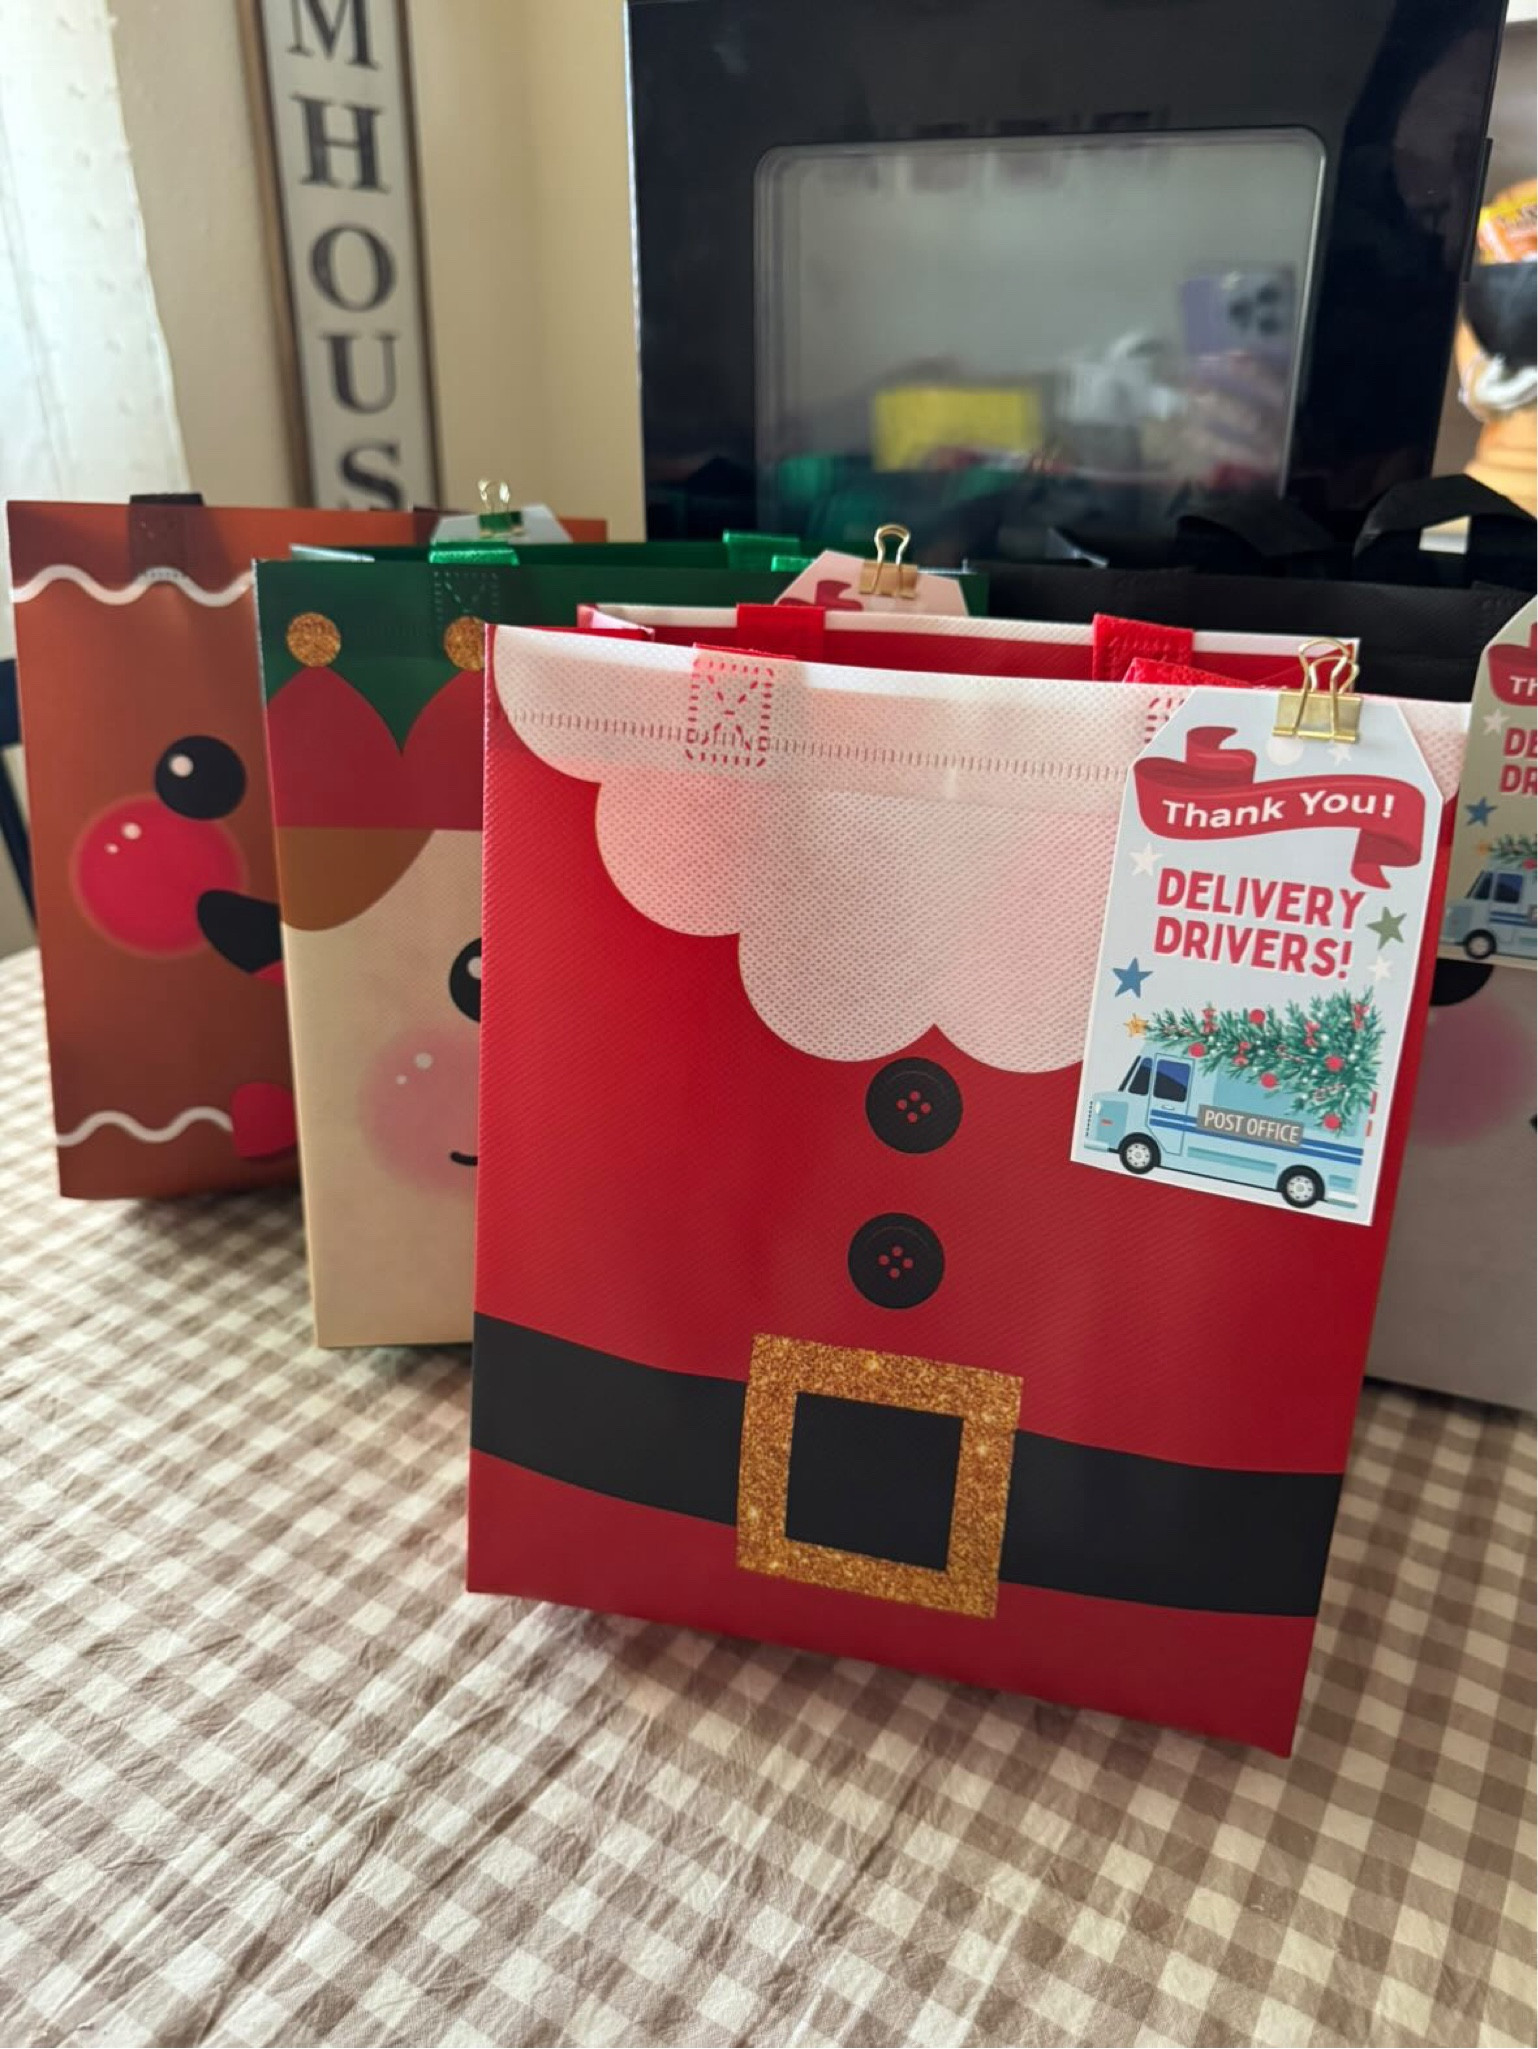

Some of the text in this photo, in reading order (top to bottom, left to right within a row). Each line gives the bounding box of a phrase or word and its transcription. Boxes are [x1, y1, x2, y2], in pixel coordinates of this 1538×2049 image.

[1162, 790, 1395, 829] Thank You!
[1157, 867, 1366, 930] DELIVERY
[1153, 916, 1353, 980] DRIVERS!
[1204, 1109, 1300, 1144] POST OFFICE
